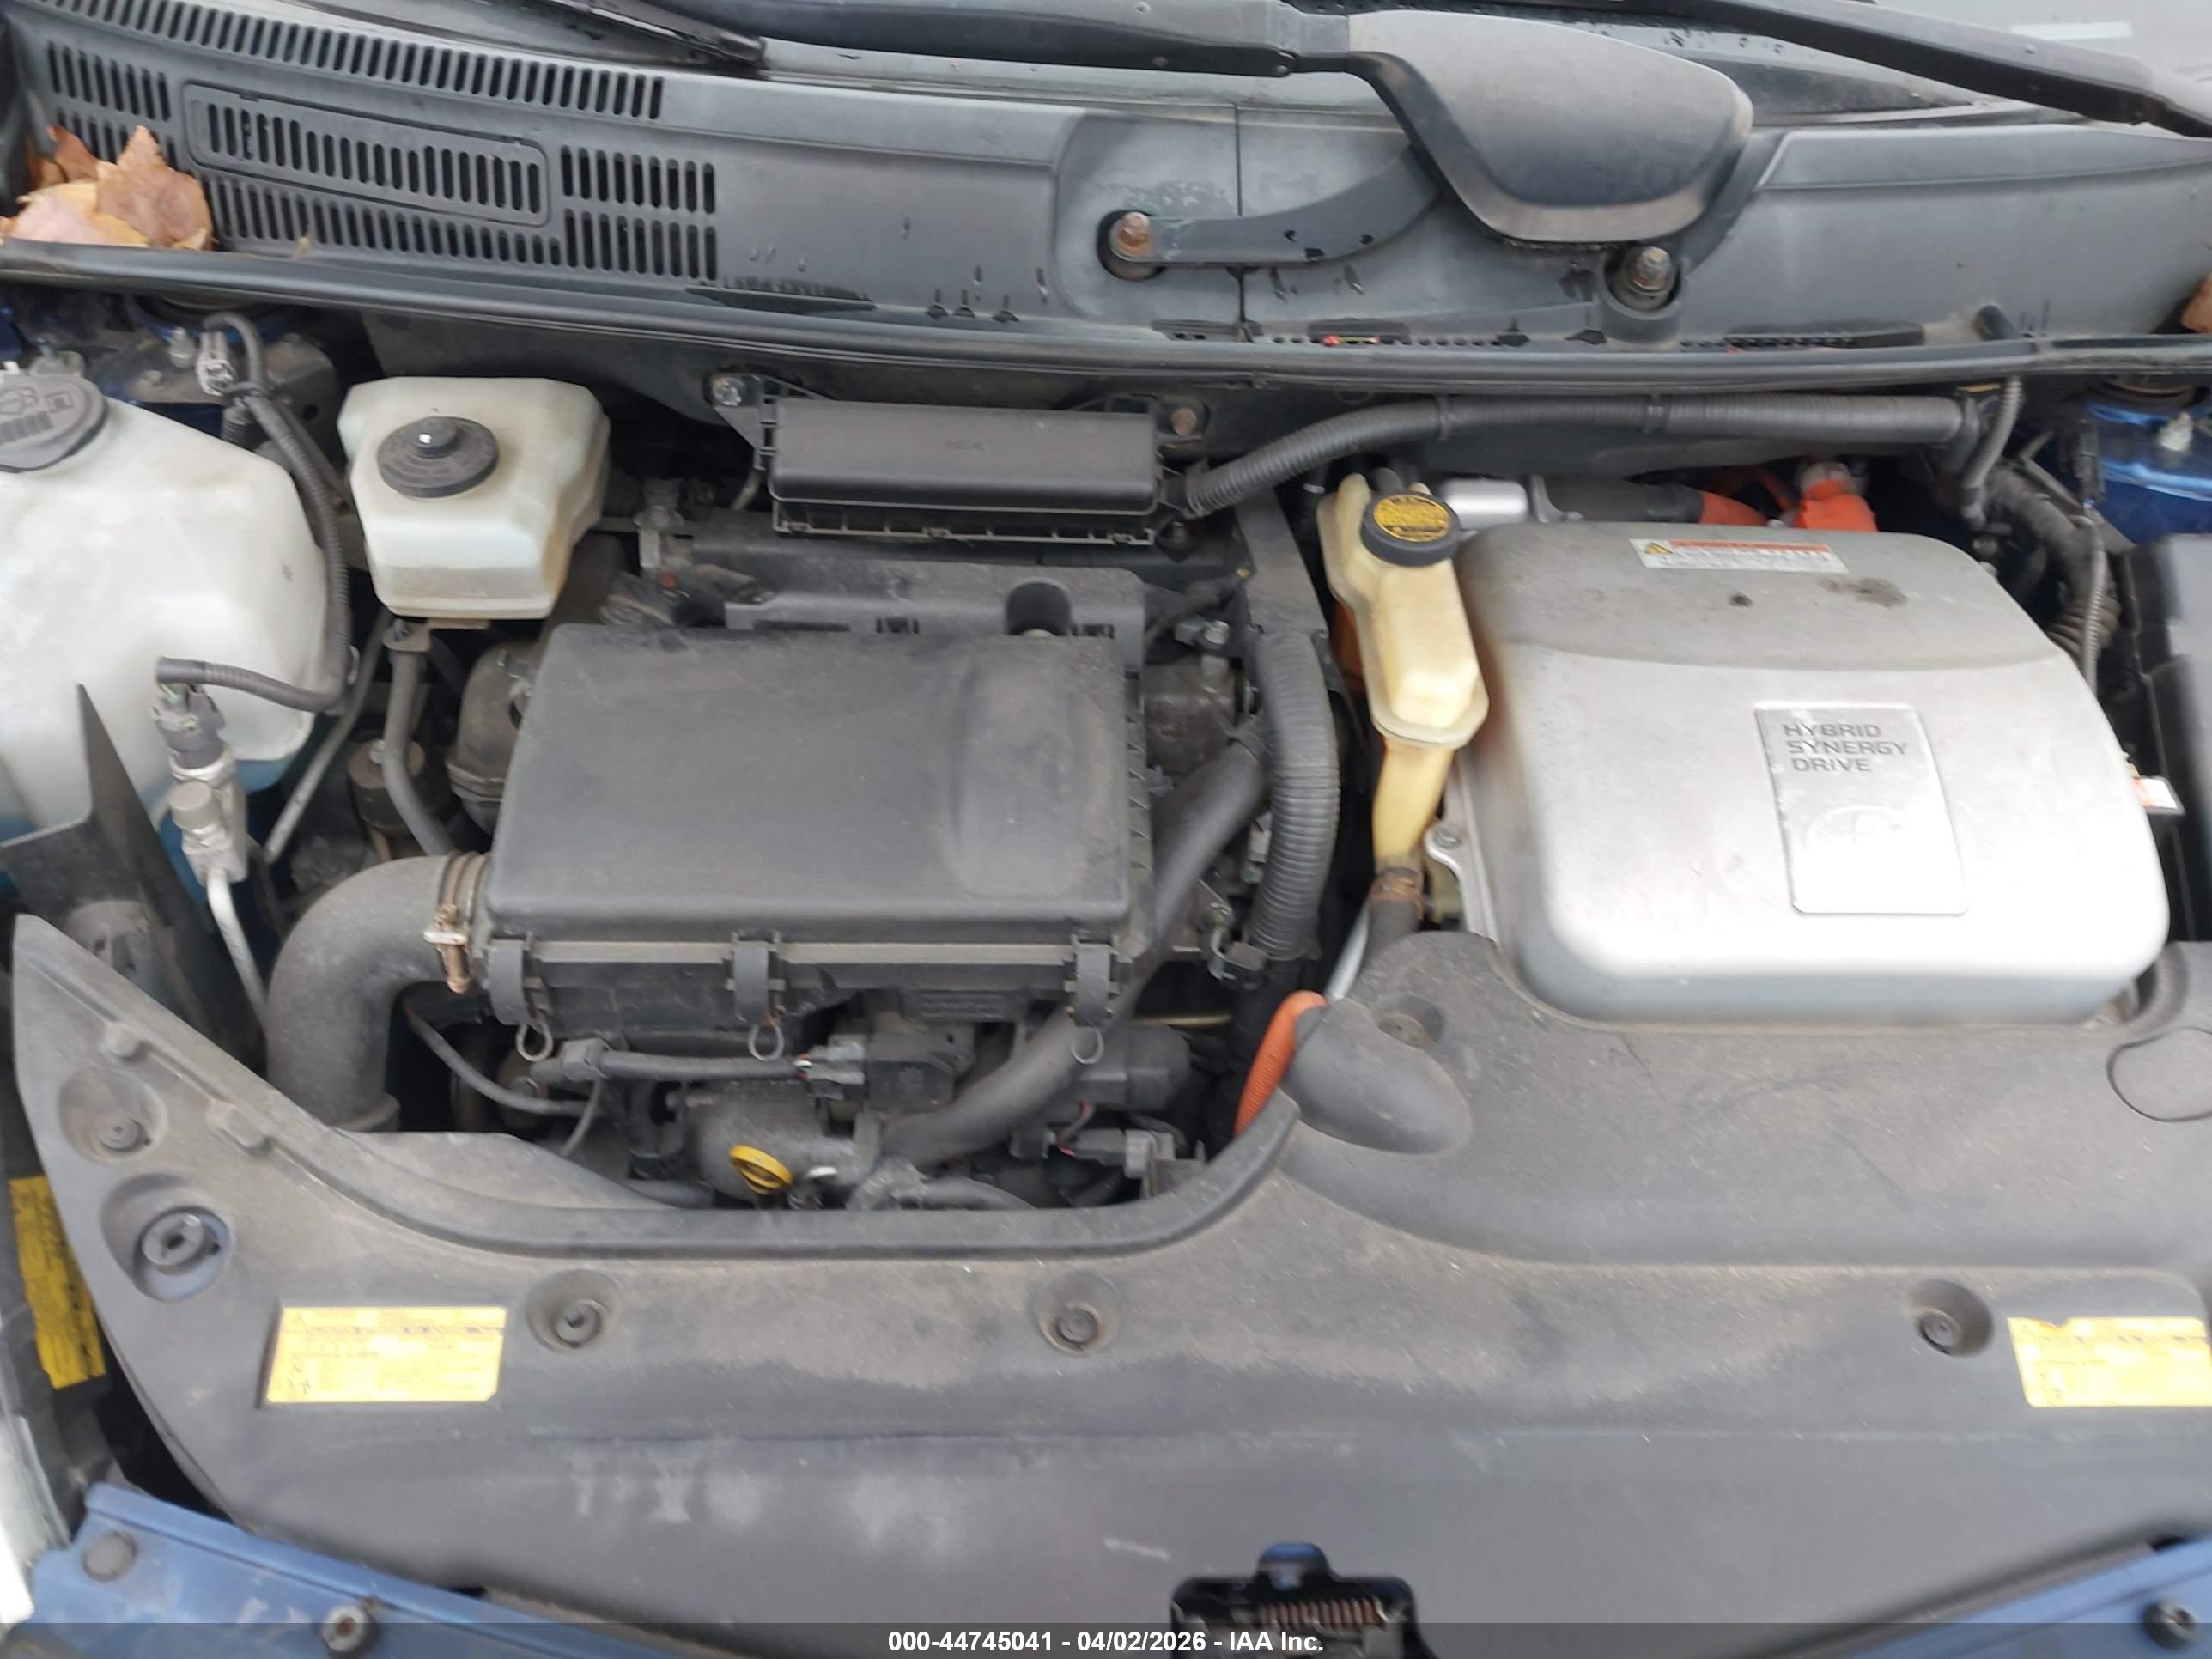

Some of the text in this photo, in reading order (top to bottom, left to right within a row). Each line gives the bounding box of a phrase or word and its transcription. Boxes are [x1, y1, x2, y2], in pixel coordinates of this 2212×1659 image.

[1783, 724, 1881, 737] HYBRID
[1787, 741, 1907, 755] SYNERGY
[1793, 758, 1871, 772] DRIVE
